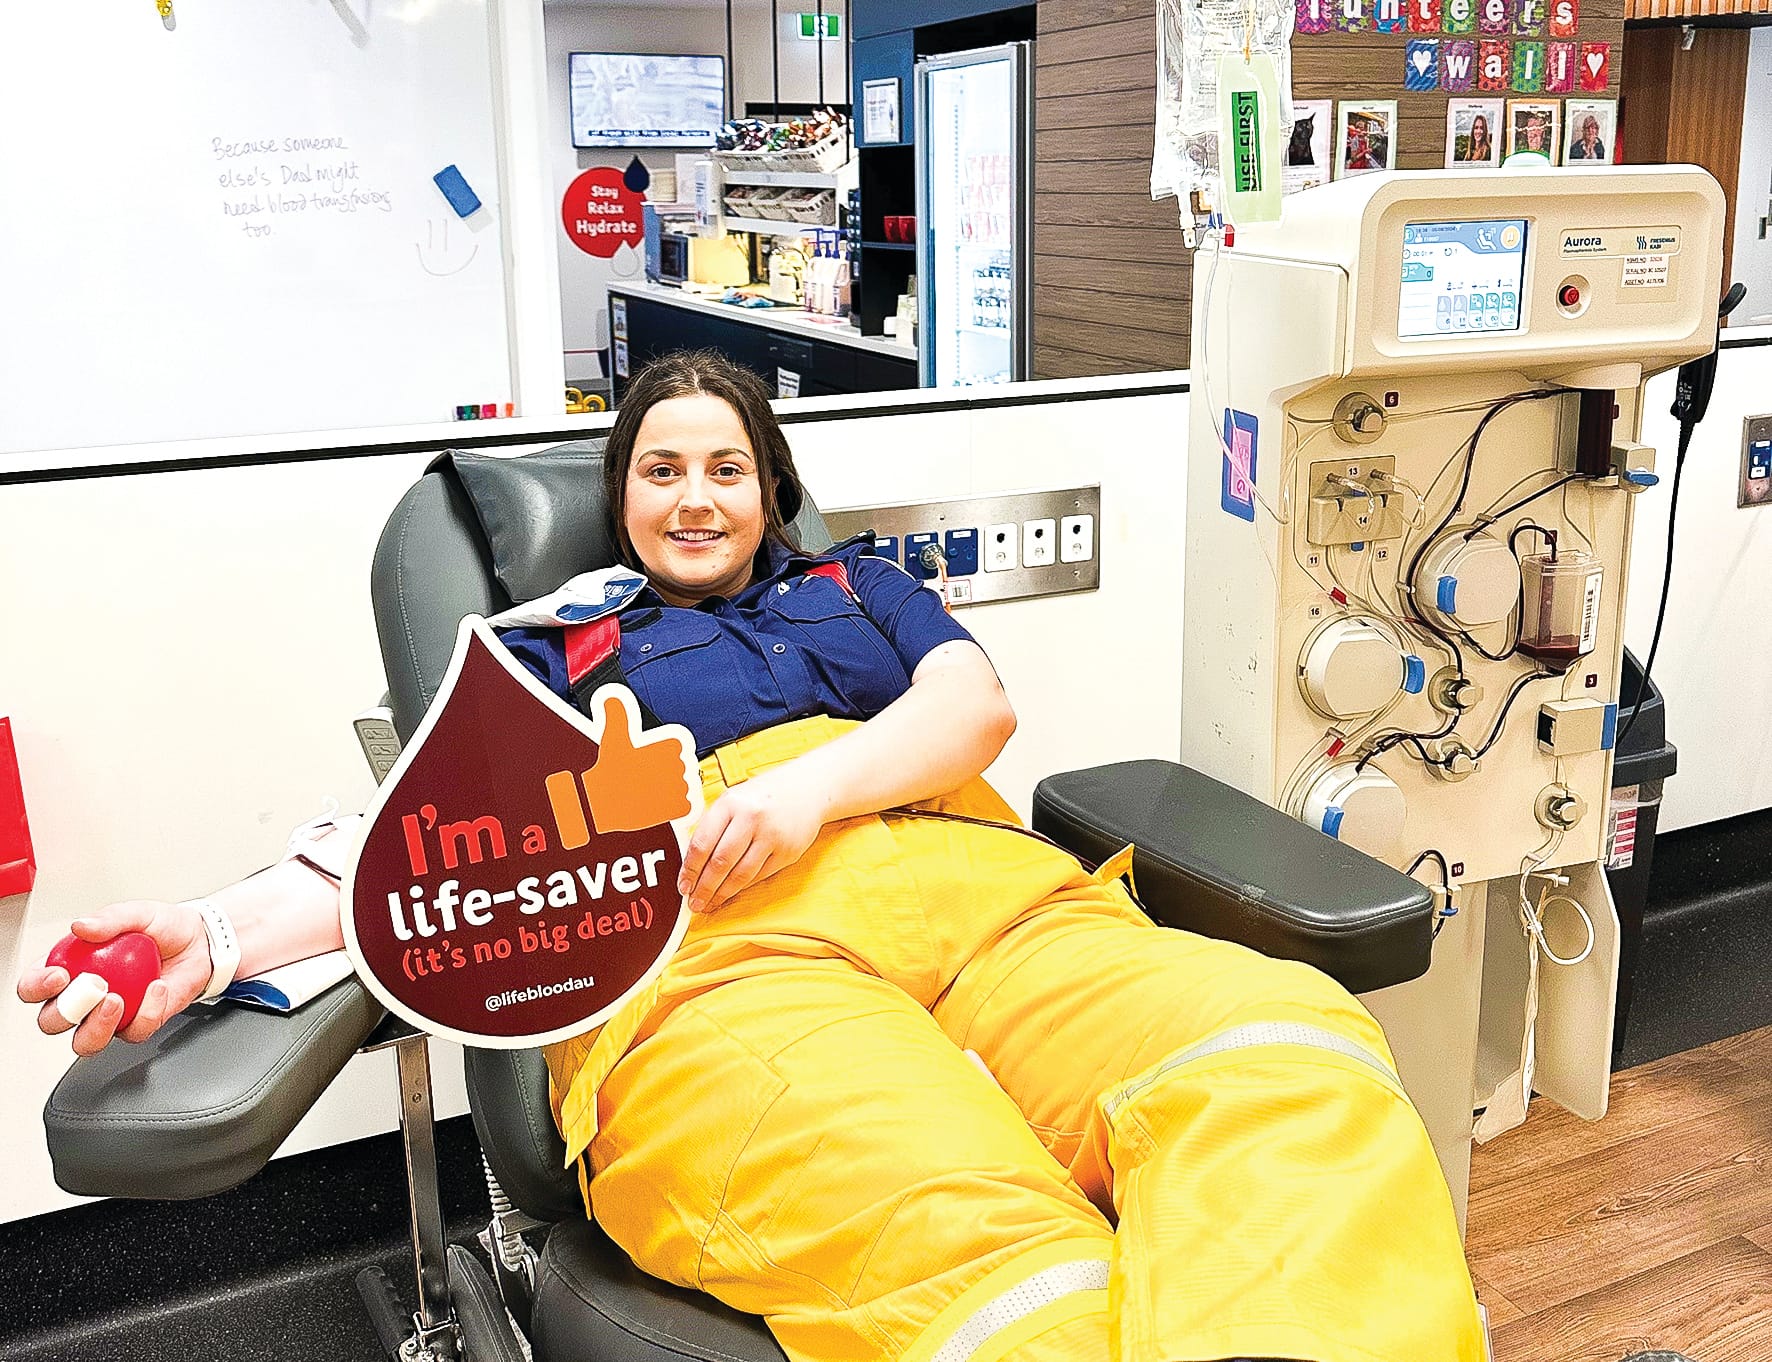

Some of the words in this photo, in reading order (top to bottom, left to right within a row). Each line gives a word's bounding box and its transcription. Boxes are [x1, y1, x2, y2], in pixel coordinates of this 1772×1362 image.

[1445, 50, 1567, 80] wall
[1238, 92, 1254, 147] FIRST
[212, 136, 279, 160] Because
[283, 137, 349, 153] someone
[218, 165, 272, 188] else's
[280, 163, 312, 185] Dad
[316, 161, 360, 194] might
[590, 184, 619, 200] Stay
[223, 194, 264, 216] need
[267, 192, 307, 214] blood
[587, 201, 625, 215] Relax
[575, 219, 637, 238] Hydrate
[1563, 236, 1602, 247] Aurora
[1348, 467, 1358, 476] 13
[1359, 516, 1368, 525] 14
[1309, 556, 1318, 564] 11
[1377, 550, 1387, 559] 12
[401, 803, 508, 877] I'm
[521, 824, 547, 855] a
[1453, 866, 1462, 874] 10
[386, 849, 666, 941] life-saver
[402, 939, 467, 982] (it's
[474, 937, 512, 965] no
[518, 920, 571, 953] big
[576, 896, 655, 940] deal)
[485, 974, 595, 1012] @lifebloodau
